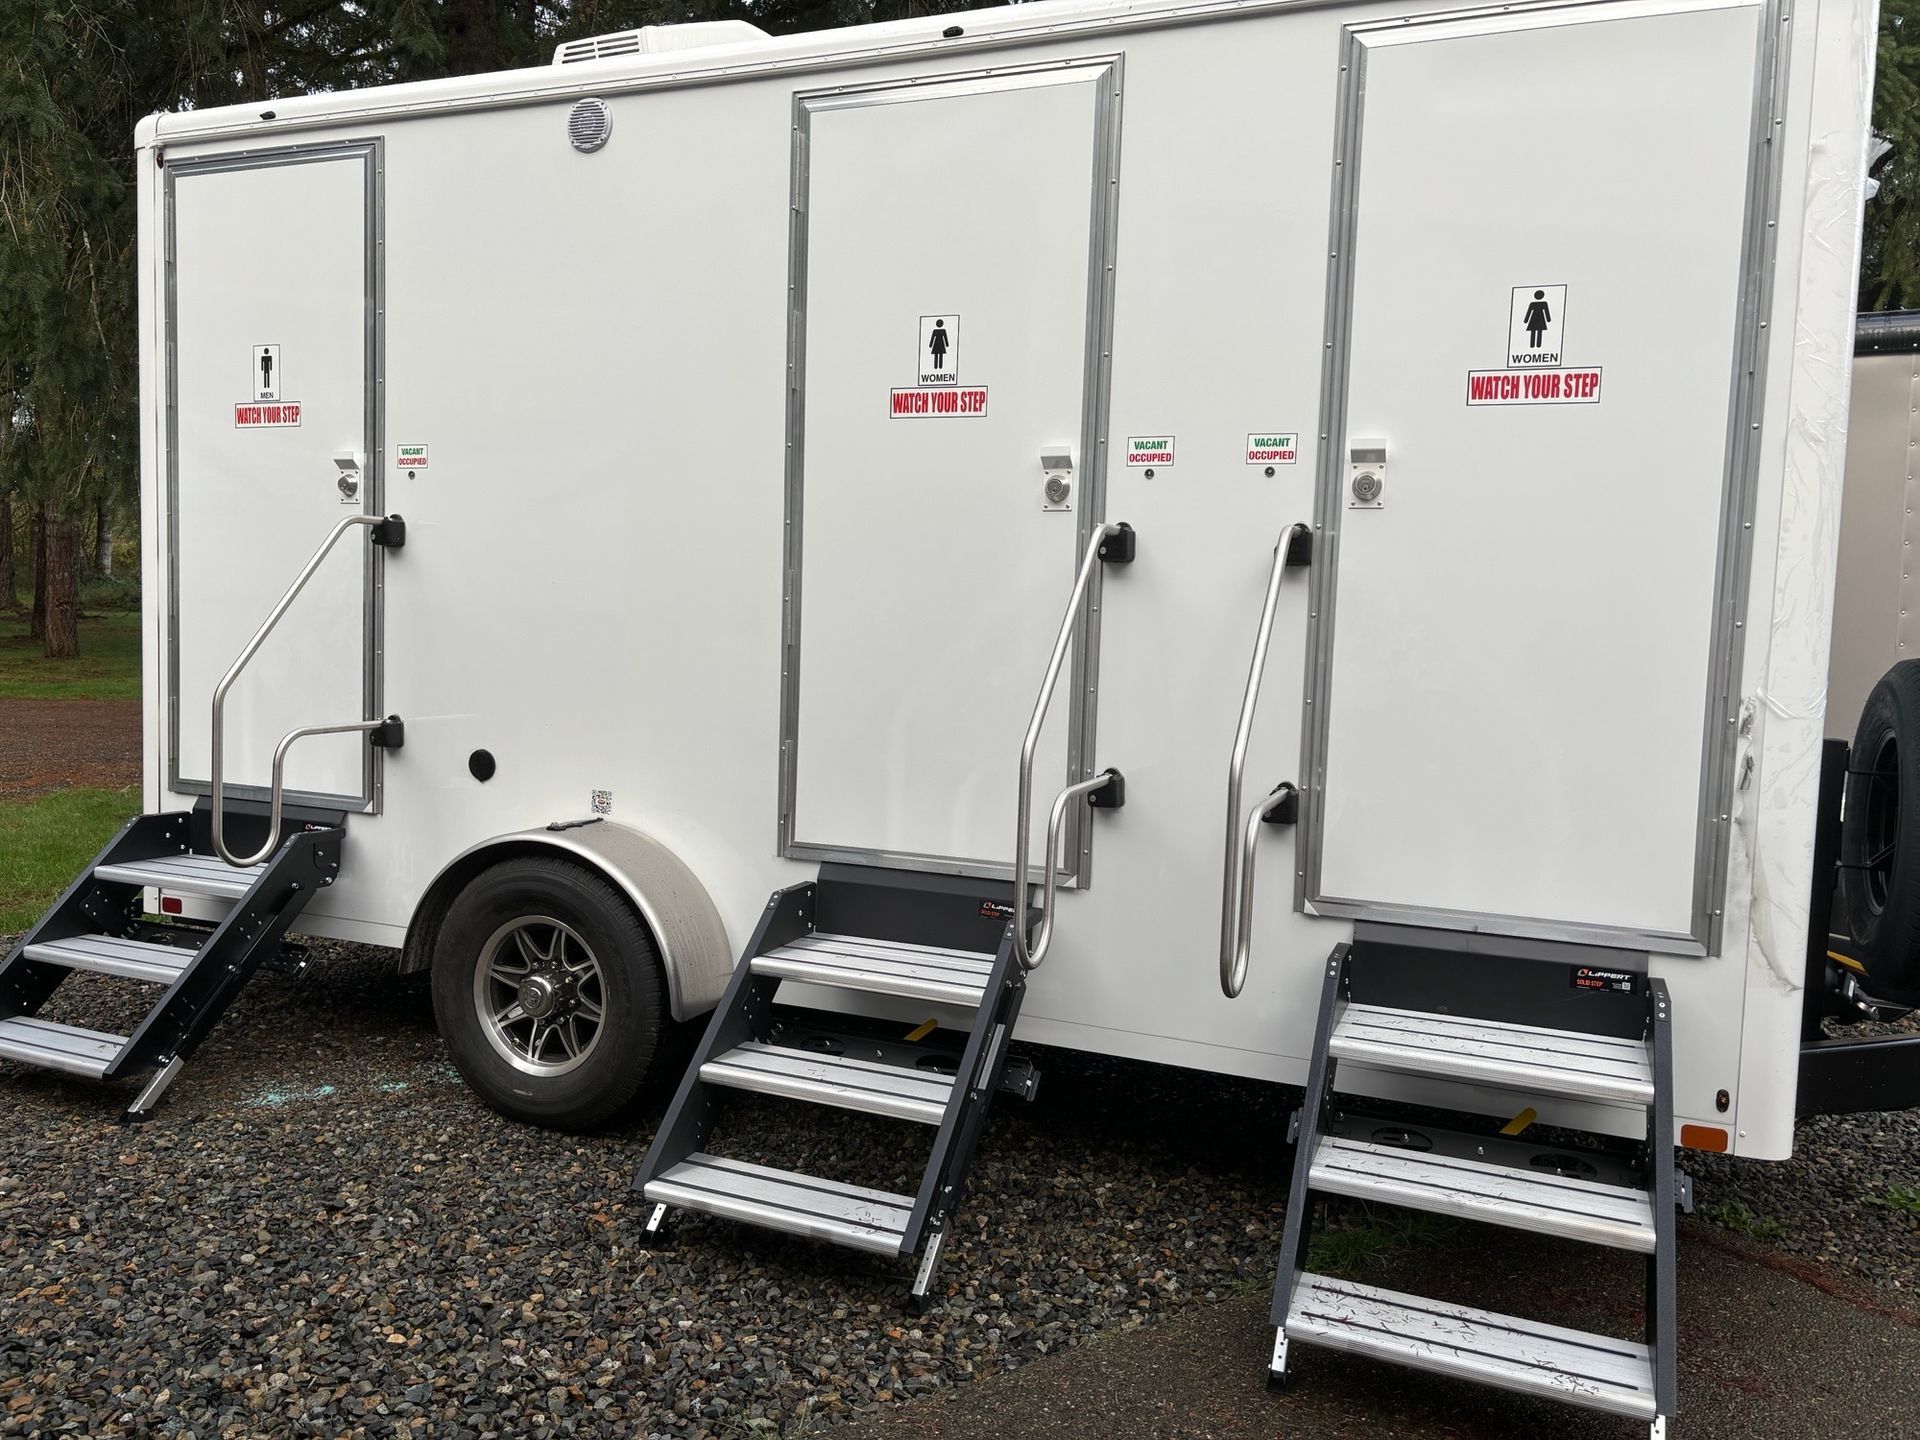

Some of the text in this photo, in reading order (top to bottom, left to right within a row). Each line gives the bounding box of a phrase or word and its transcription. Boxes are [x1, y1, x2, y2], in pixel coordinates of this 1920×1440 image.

[1512, 353, 1558, 363] WOMEN
[921, 373, 955, 382] WOMEN
[1471, 373, 1599, 400] WATCH YOUR STEP
[893, 391, 985, 413] WATCH YOUR STEP
[236, 405, 300, 424] WATCH YOUR STEP
[1134, 440, 1168, 450] VACANT
[1254, 437, 1291, 447] VACANT
[401, 447, 424, 456] VACANT
[1248, 450, 1295, 460] OCCUPIED
[398, 457, 427, 466] OCCUPIED
[1129, 453, 1172, 462] OCCUPIED
[1588, 970, 1633, 980] LIPPERT
